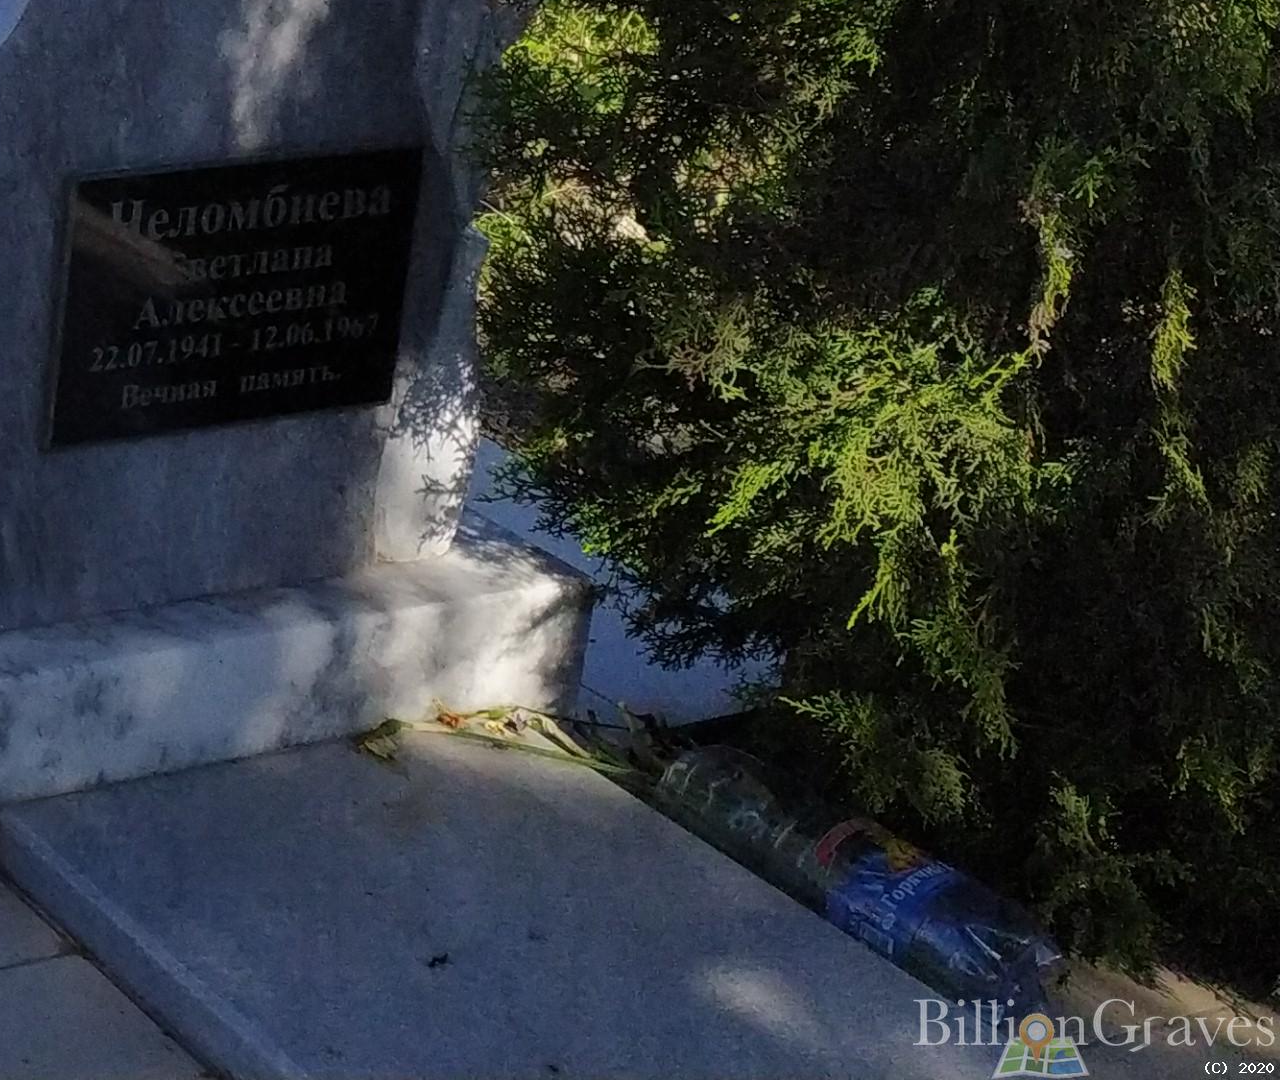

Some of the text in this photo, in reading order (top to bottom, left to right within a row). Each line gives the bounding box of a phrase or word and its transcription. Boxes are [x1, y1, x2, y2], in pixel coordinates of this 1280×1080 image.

[112, 184, 392, 241] Челомбиева
[134, 280, 348, 329] Алексеевна
[90, 333, 222, 371] 22.07.1941
[121, 366, 341, 408] Вечная память.
